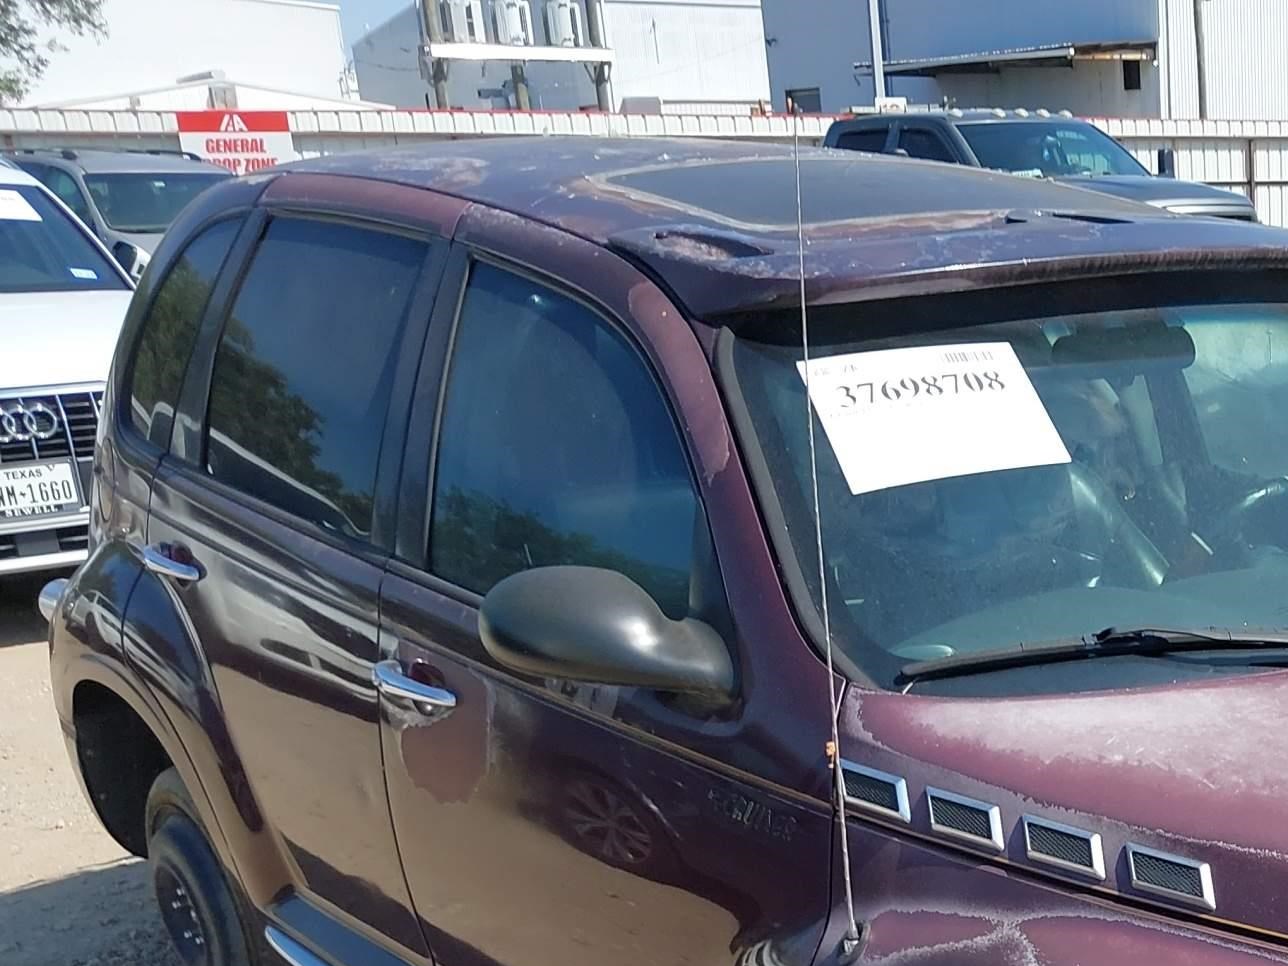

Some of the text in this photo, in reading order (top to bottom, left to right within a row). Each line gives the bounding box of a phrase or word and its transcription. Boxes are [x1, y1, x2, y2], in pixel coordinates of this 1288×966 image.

[205, 139, 267, 153] GENERAL
[836, 370, 1006, 408] 37698708
[4, 468, 42, 480] TEXAS
